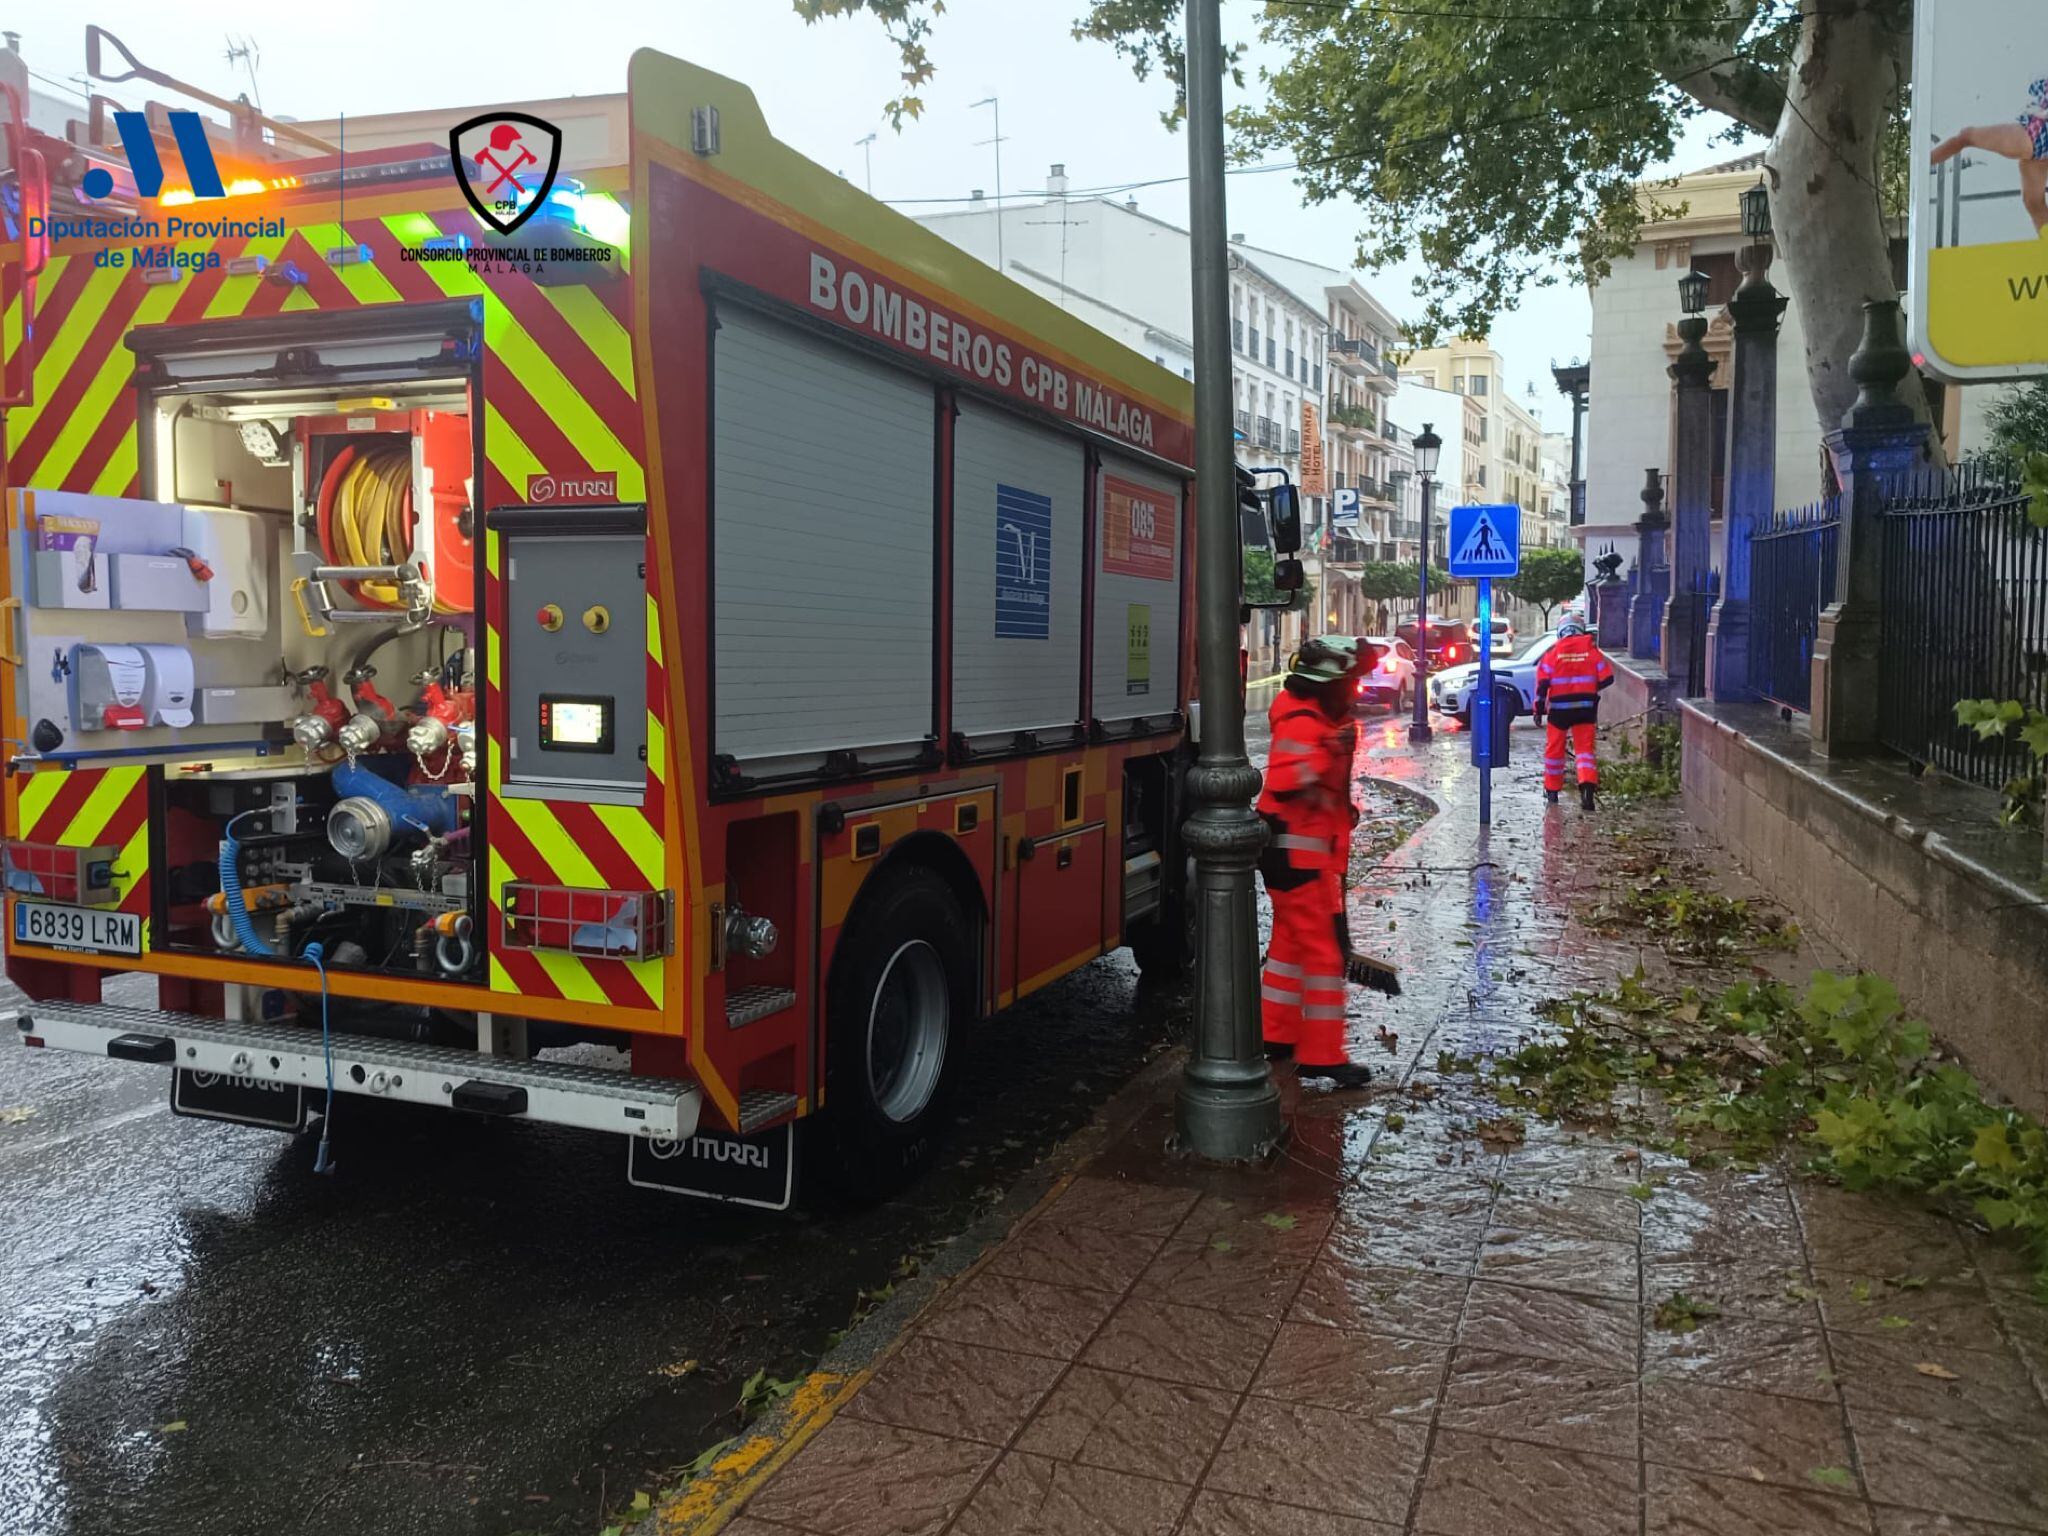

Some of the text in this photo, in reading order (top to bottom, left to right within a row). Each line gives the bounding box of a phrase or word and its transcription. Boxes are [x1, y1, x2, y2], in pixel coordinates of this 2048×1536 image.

[810, 252, 1154, 447] BOMBEROS CPB MÁLAGA
[1302, 406, 1313, 476] MAESTRANZA
[1311, 443, 1321, 476] HOTEL
[561, 480, 614, 497] ITURRI
[1334, 488, 1357, 515] P
[1132, 499, 1156, 540] 085
[30, 910, 133, 947] 6839 LRM
[692, 1136, 769, 1169] ITURRI
